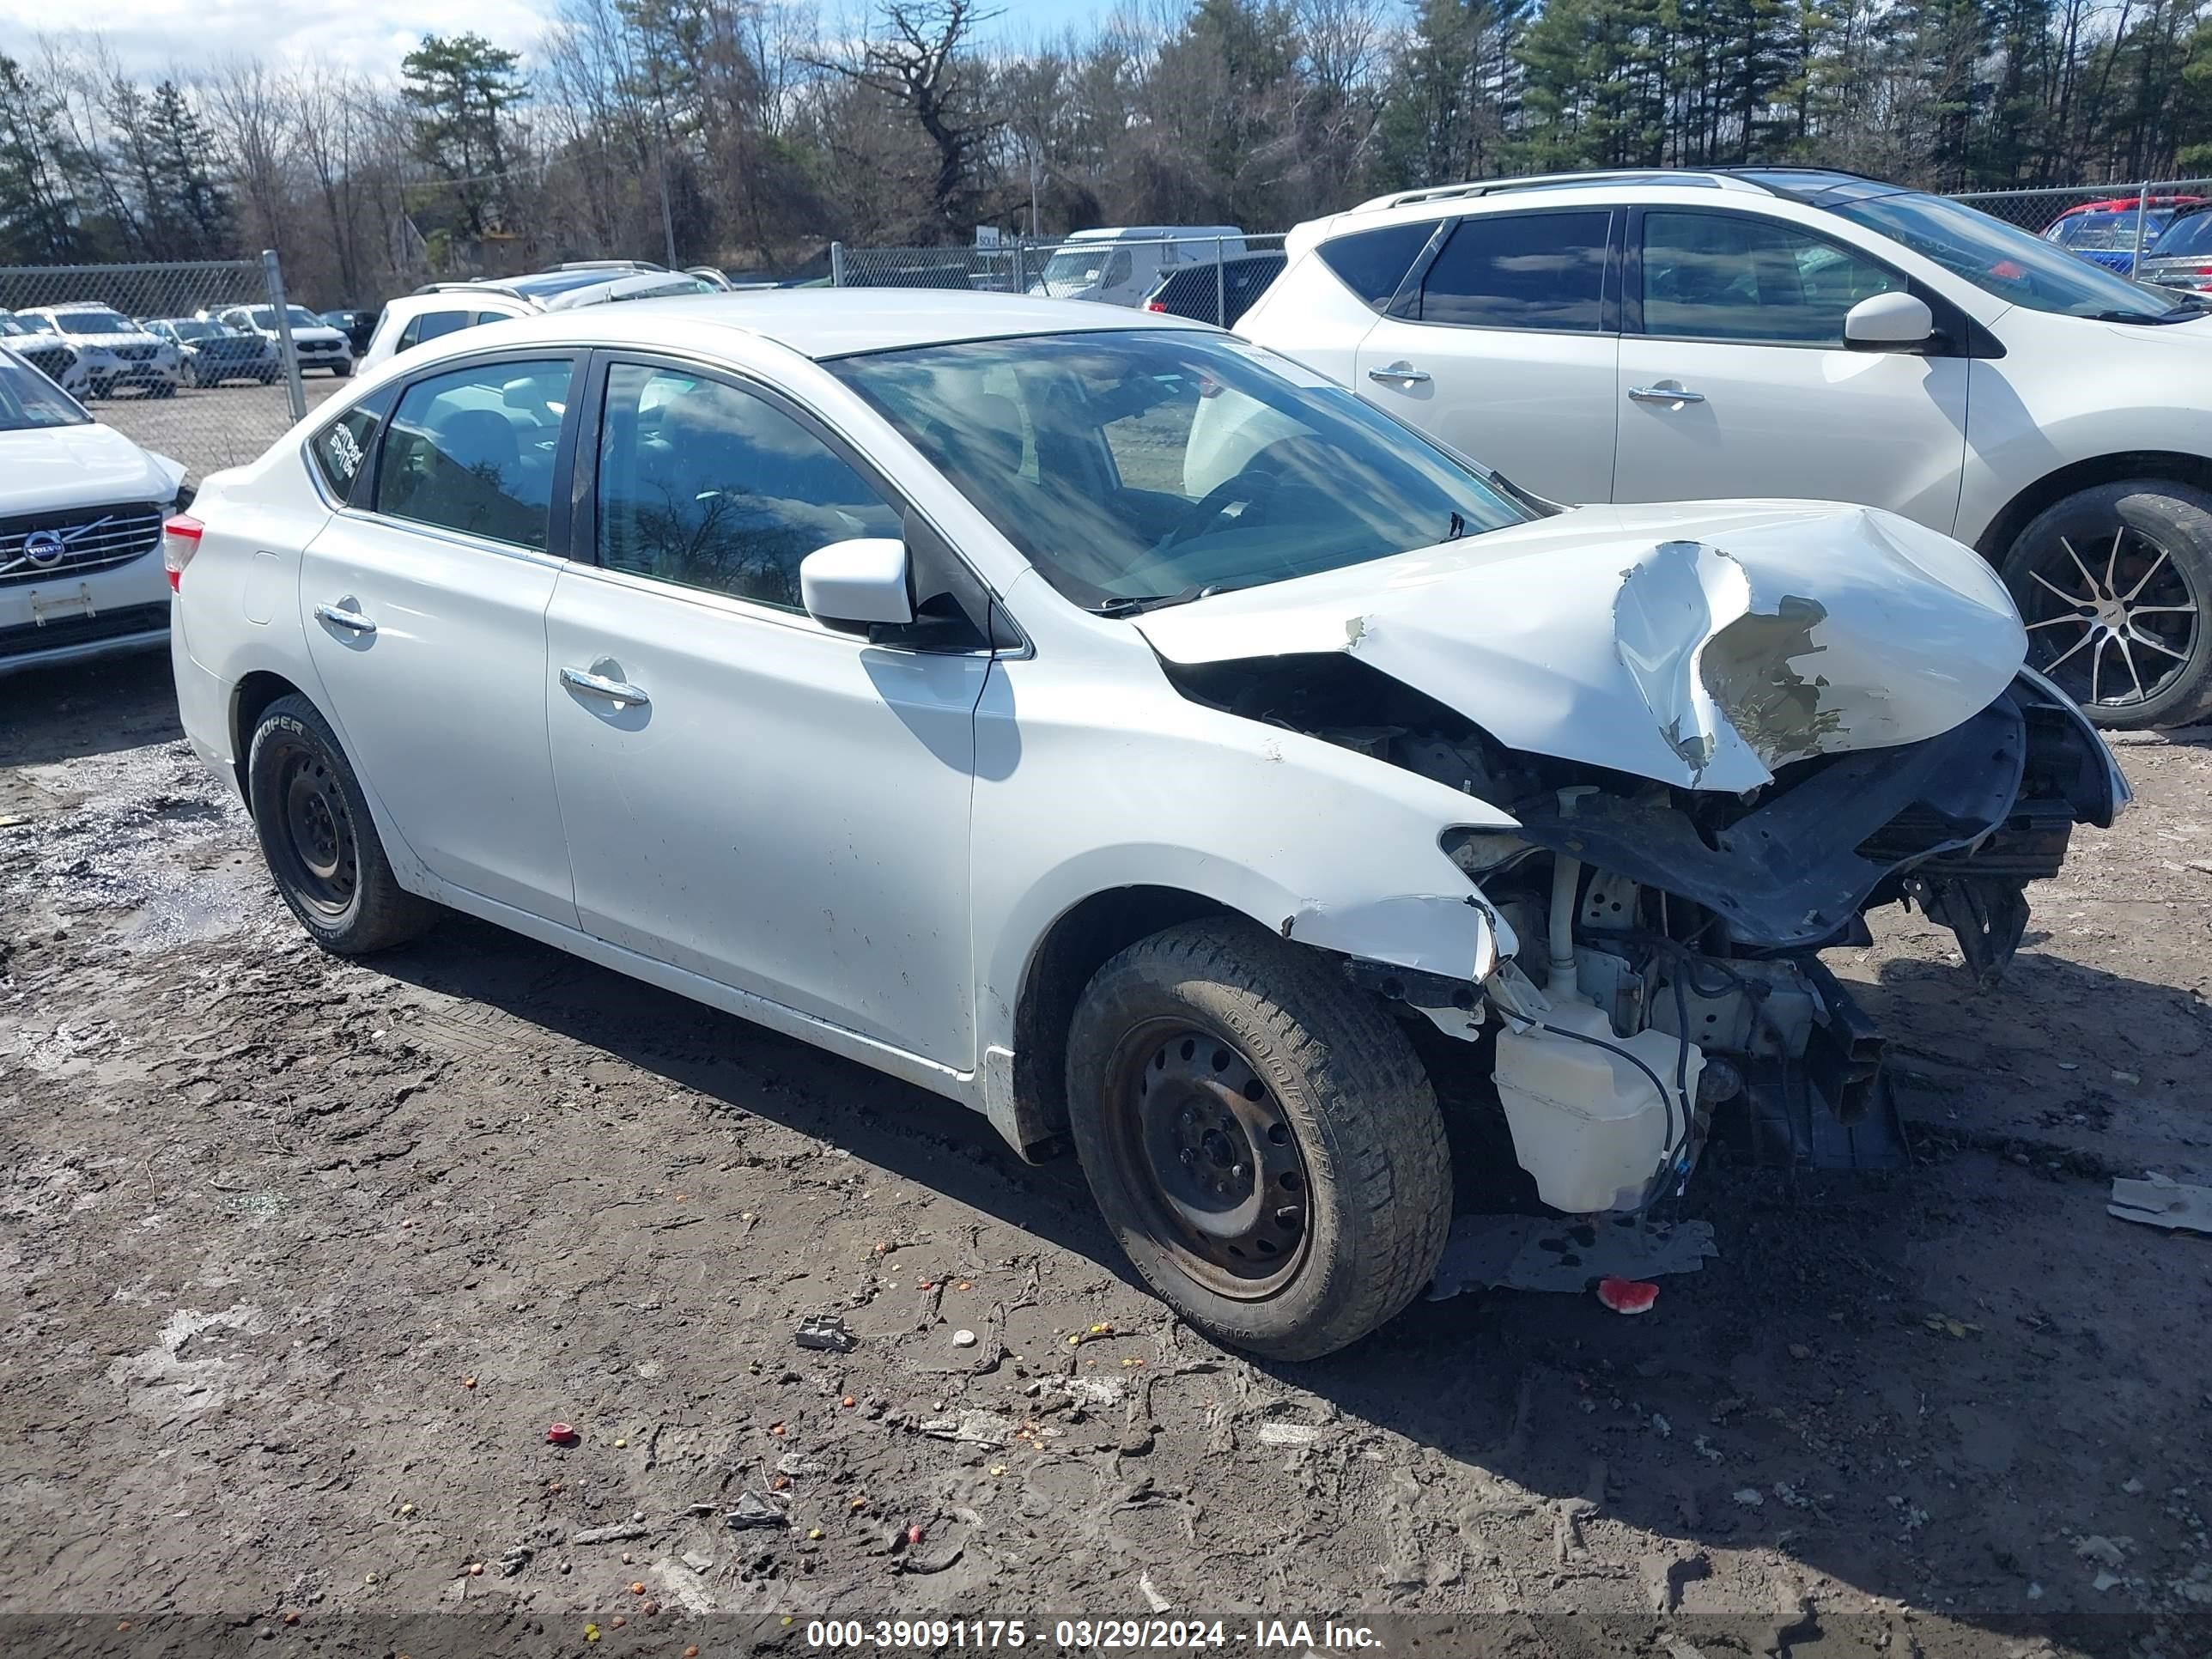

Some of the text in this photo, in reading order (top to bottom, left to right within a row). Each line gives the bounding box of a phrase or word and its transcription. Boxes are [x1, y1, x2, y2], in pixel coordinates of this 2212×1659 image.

[27, 545, 61, 555] VOLVO
[250, 715, 303, 763] COOPER
[1224, 1008, 1335, 1179] COOPER
